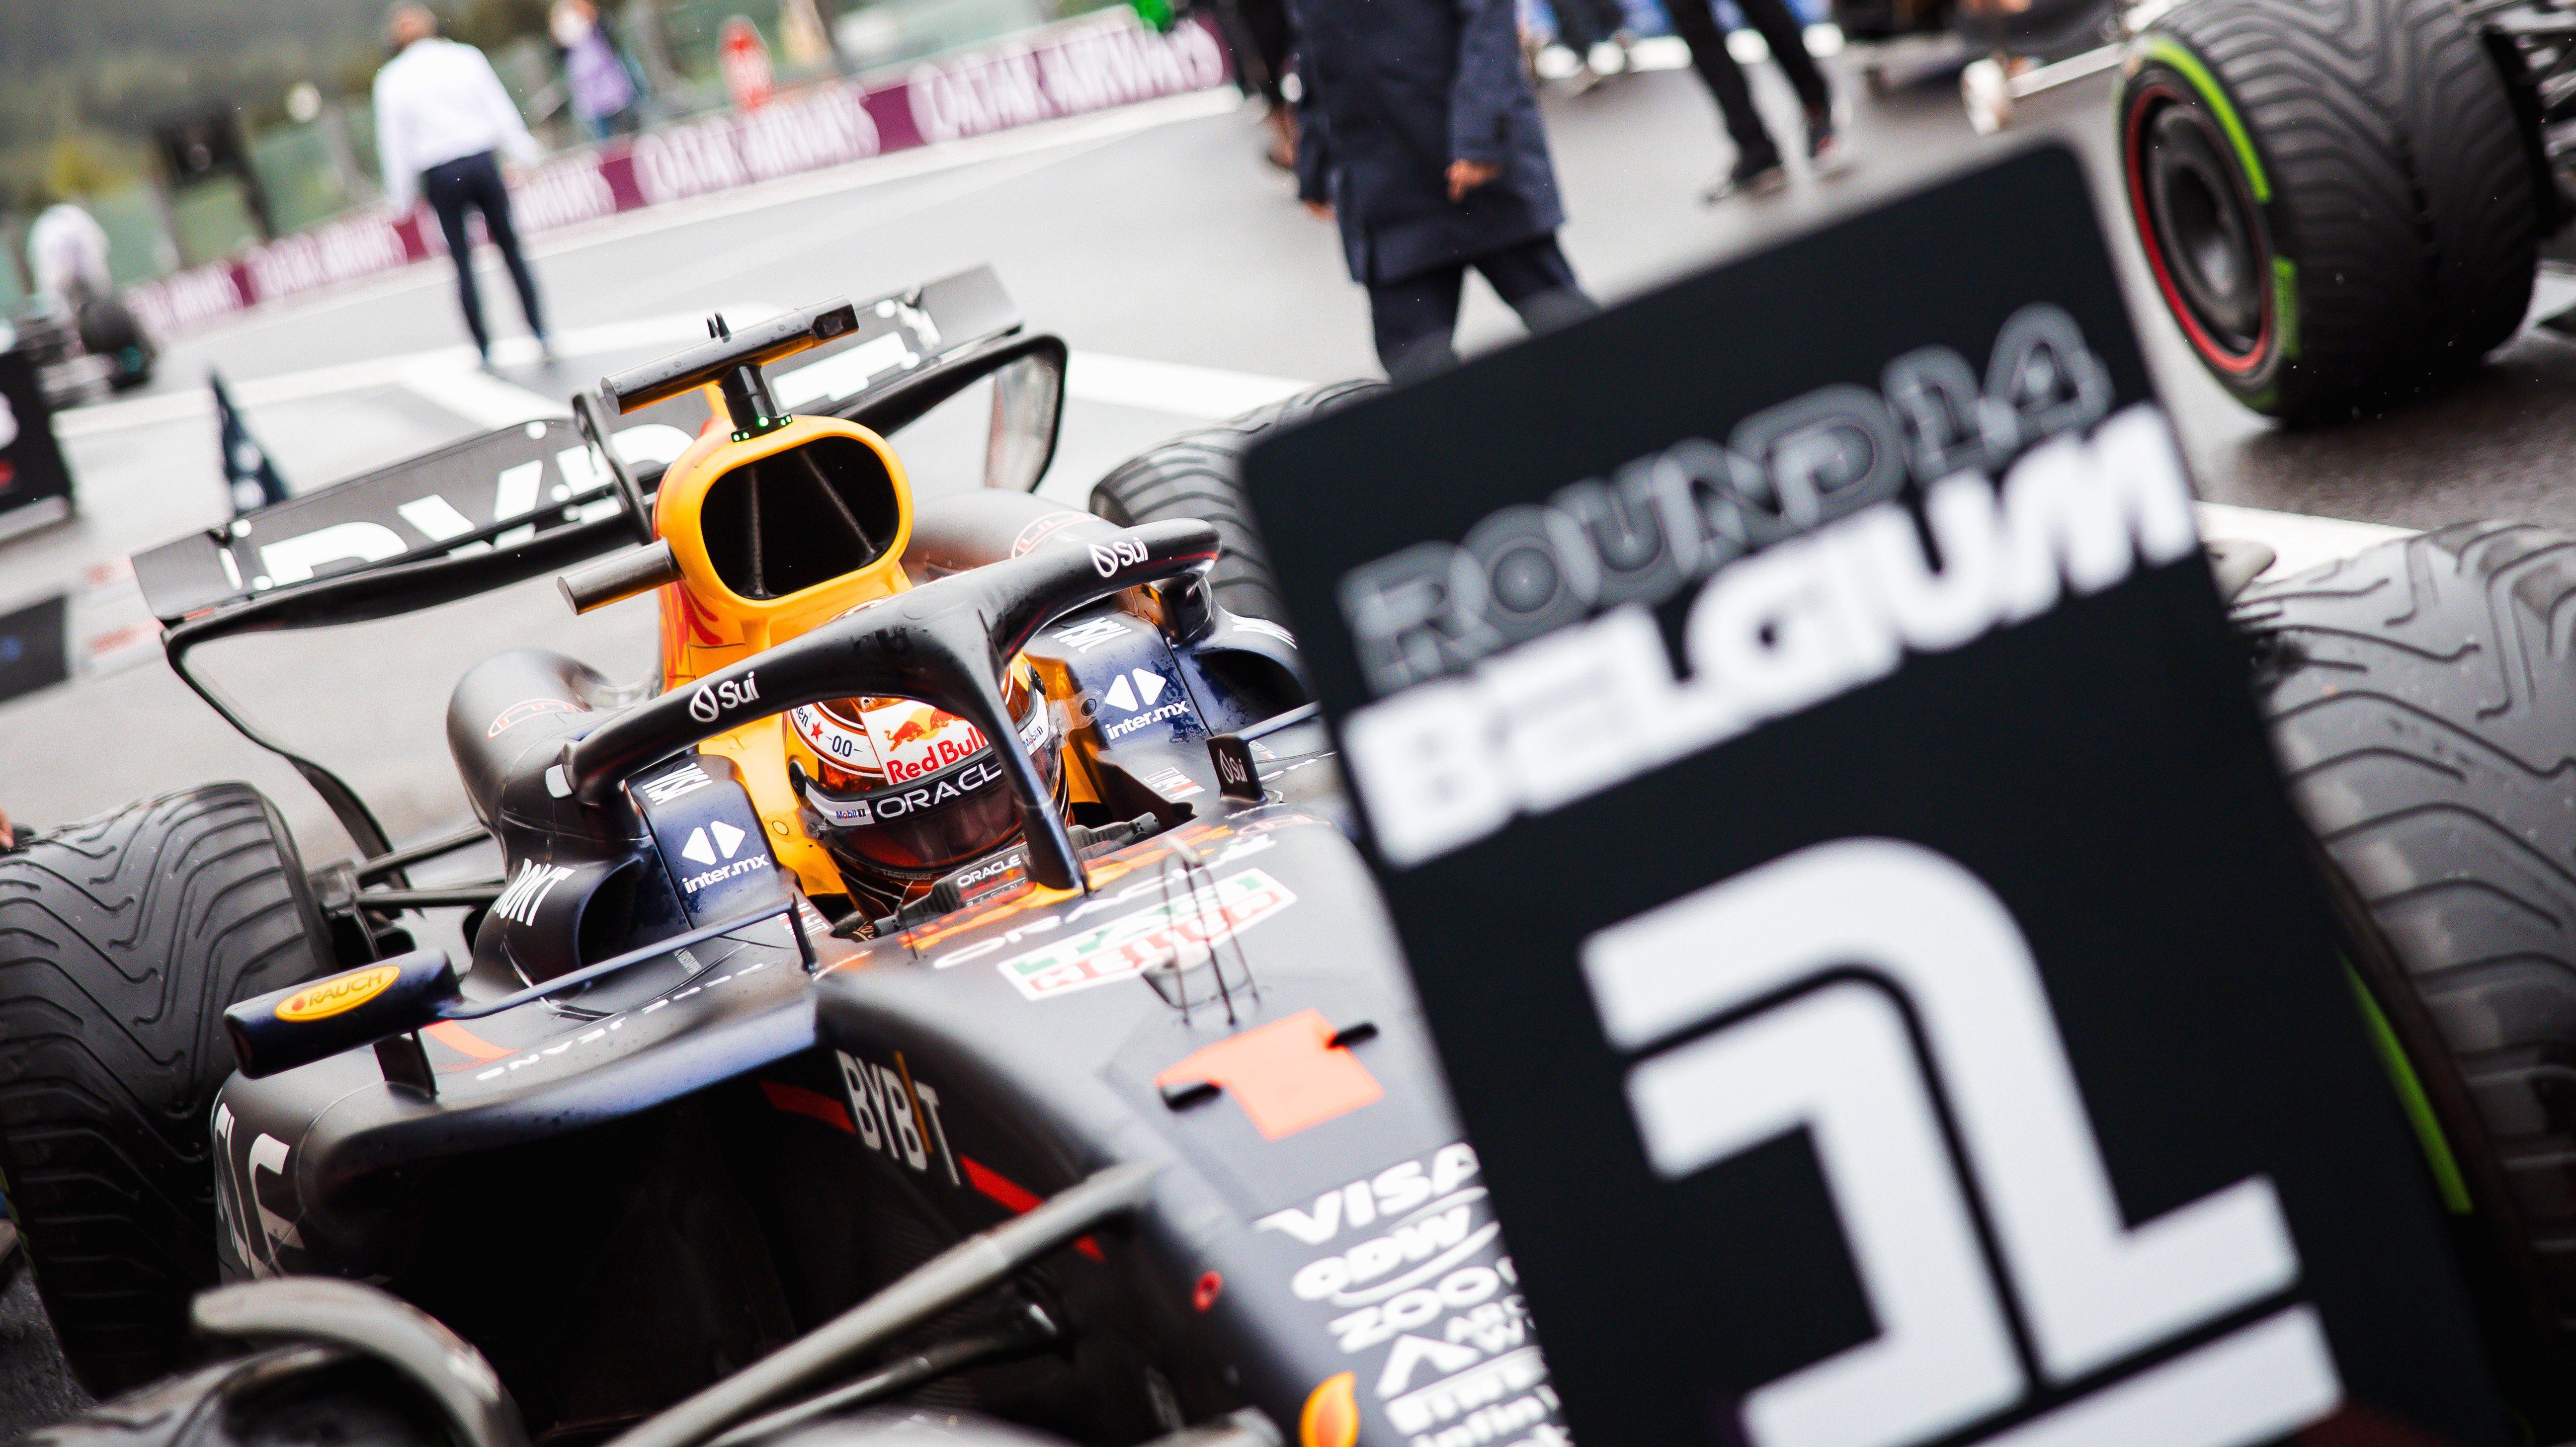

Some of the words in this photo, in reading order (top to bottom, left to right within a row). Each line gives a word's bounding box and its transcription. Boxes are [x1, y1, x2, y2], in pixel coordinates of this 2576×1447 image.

[1334, 384, 1908, 696] ROUND
[1881, 303, 2116, 489] 14
[1113, 537, 1149, 566] Sui
[1339, 403, 2203, 871] BELGIUM
[718, 671, 760, 704] Sui
[1105, 699, 1191, 741] inter.mx
[886, 745, 940, 784] Red
[937, 726, 987, 765] Bull
[1229, 756, 1248, 782] Sui
[876, 763, 1002, 818] ORACL
[836, 809, 857, 819] Mobil
[682, 853, 770, 894] inter.mx
[957, 854, 1021, 887] ORACLE
[493, 858, 576, 926] ROKT
[309, 970, 383, 1007] RAUCH
[835, 1048, 961, 1187] BYBIT
[1253, 1142, 1481, 1245] VISA
